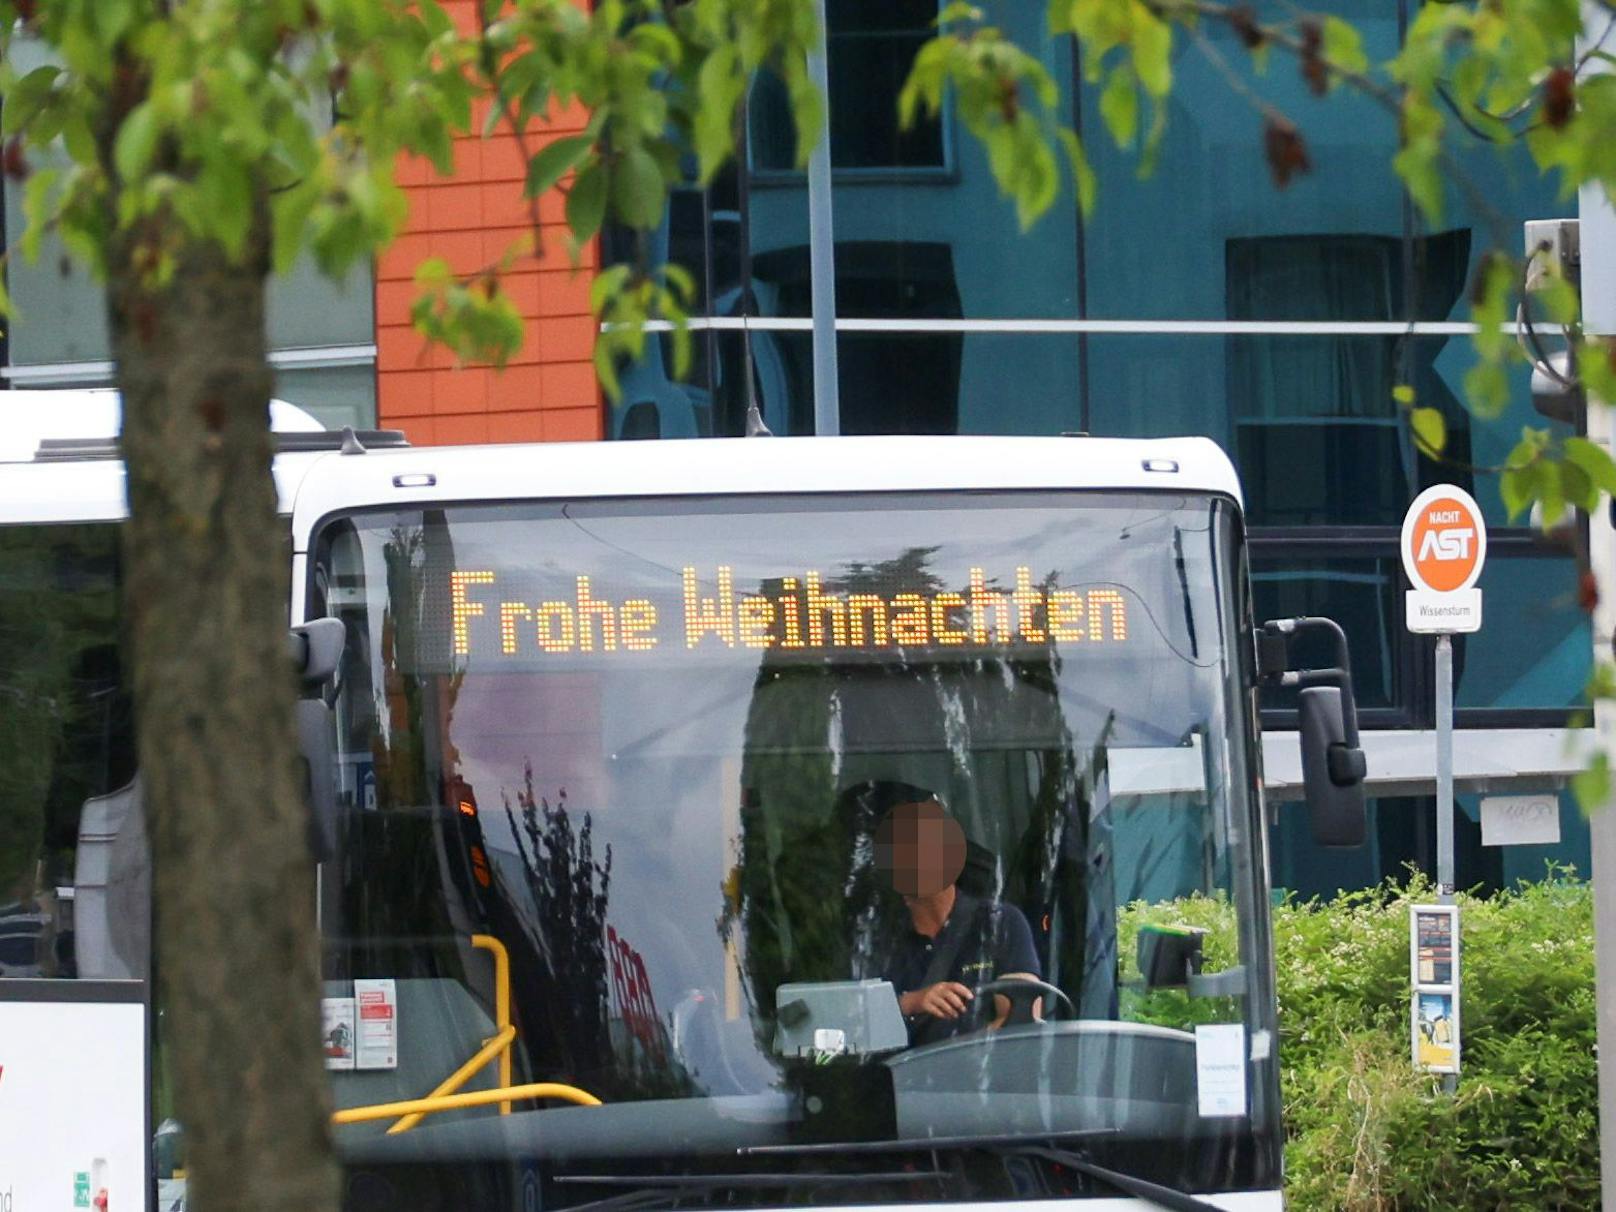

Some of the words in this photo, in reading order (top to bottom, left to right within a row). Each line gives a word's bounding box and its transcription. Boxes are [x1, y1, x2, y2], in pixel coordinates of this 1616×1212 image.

[1429, 511, 1461, 524] NACHT
[1417, 527, 1474, 562] AST
[450, 571, 657, 654] Frohe
[682, 565, 1127, 648] Weihnachten
[1419, 605, 1471, 617] Wissensturm
